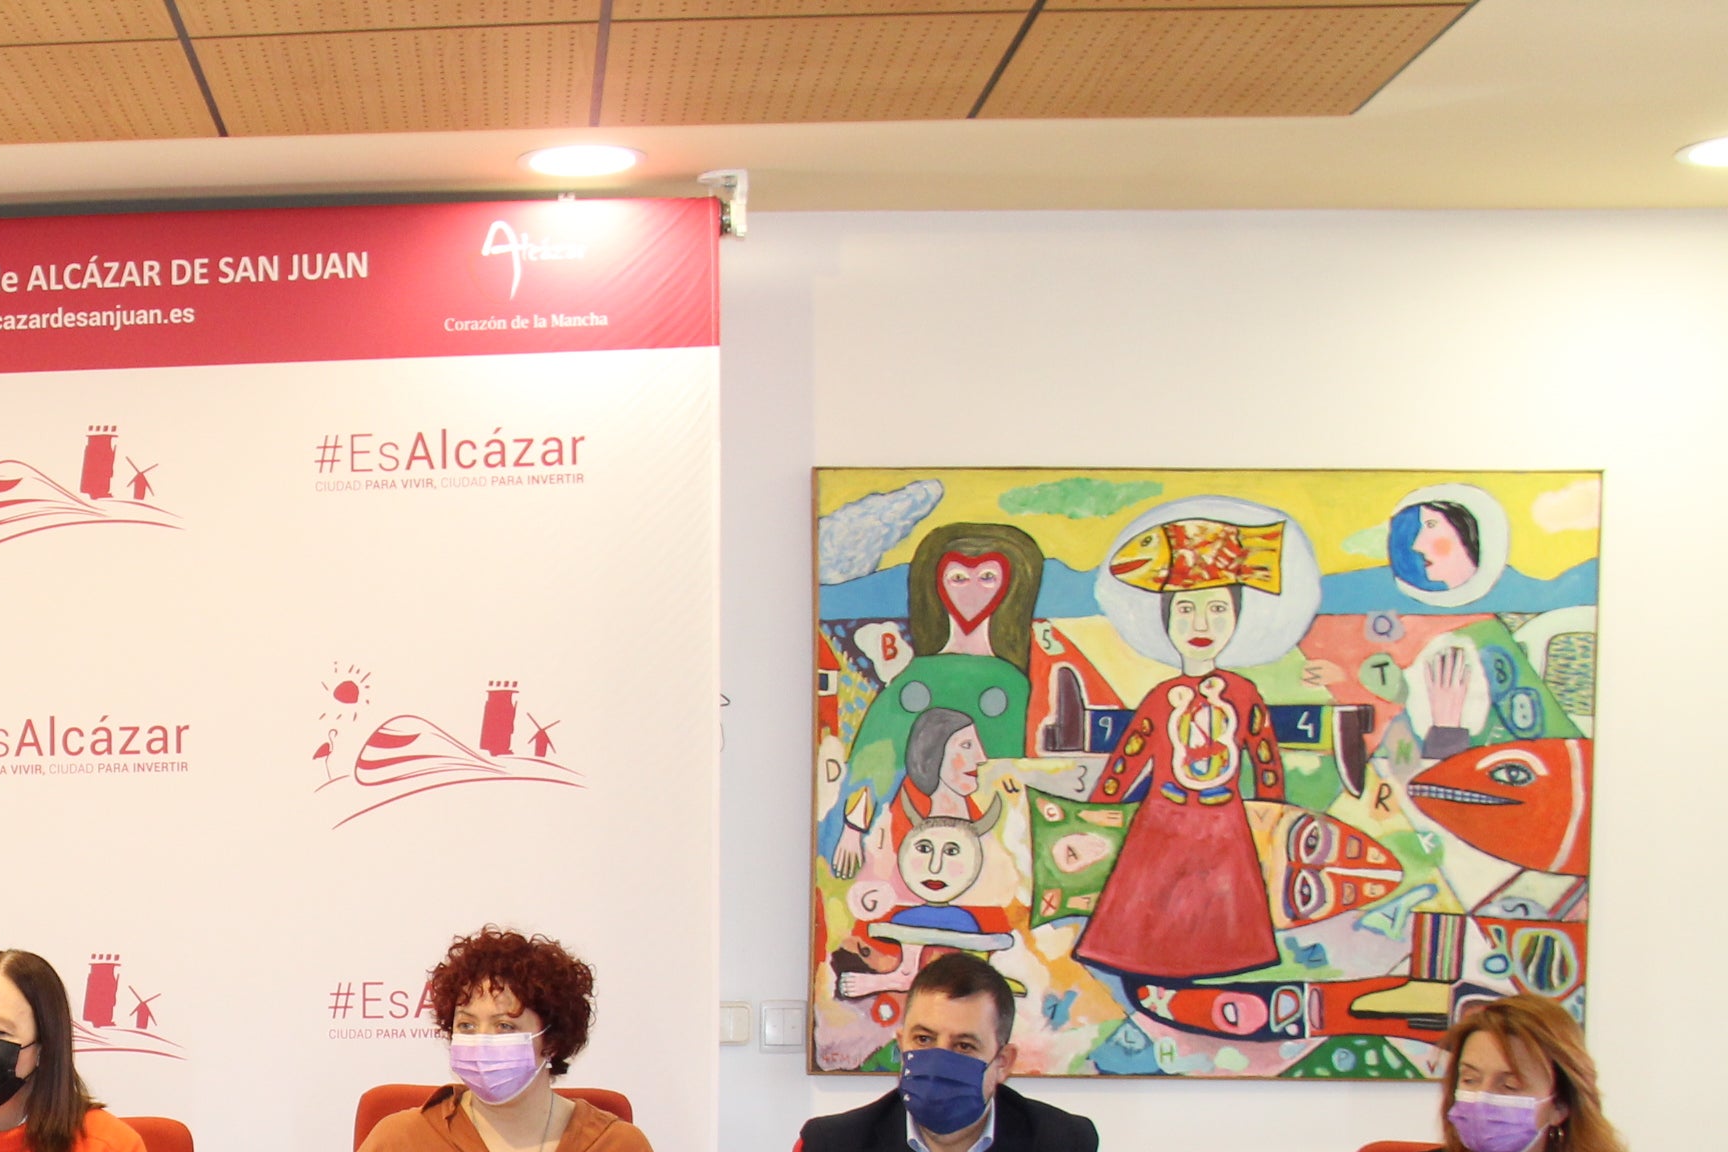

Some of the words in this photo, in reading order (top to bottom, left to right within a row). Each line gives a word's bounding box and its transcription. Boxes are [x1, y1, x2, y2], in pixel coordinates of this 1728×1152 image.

[26, 255, 162, 291] ALCÁZAR
[170, 258, 210, 286] DE
[217, 255, 279, 284] SAN
[287, 251, 369, 281] JUAN
[443, 315, 507, 332] Corazón
[510, 314, 530, 330] de
[533, 314, 547, 329] la
[550, 312, 609, 328] Mancha
[313, 426, 586, 474] #EsAlcázar
[314, 480, 362, 492] CIUDAD
[365, 479, 398, 491] PARA
[401, 478, 437, 490] VIVIR,
[440, 476, 488, 488] CIUDAD
[490, 475, 524, 487] PARA
[526, 473, 585, 486] INVERTIR
[880, 632, 898, 661] B
[1041, 629, 1052, 651] 5
[1370, 661, 1390, 686] T
[1296, 710, 1315, 740] 4
[10, 764, 46, 776] VIVIR,
[48, 763, 95, 775] CIUDAD
[97, 762, 129, 774] PARA
[132, 761, 189, 773] INVERTIR
[825, 758, 842, 783] D
[1374, 782, 1393, 813] R
[328, 1028, 373, 1040] CIUDAD
[375, 1028, 407, 1039] PARA
